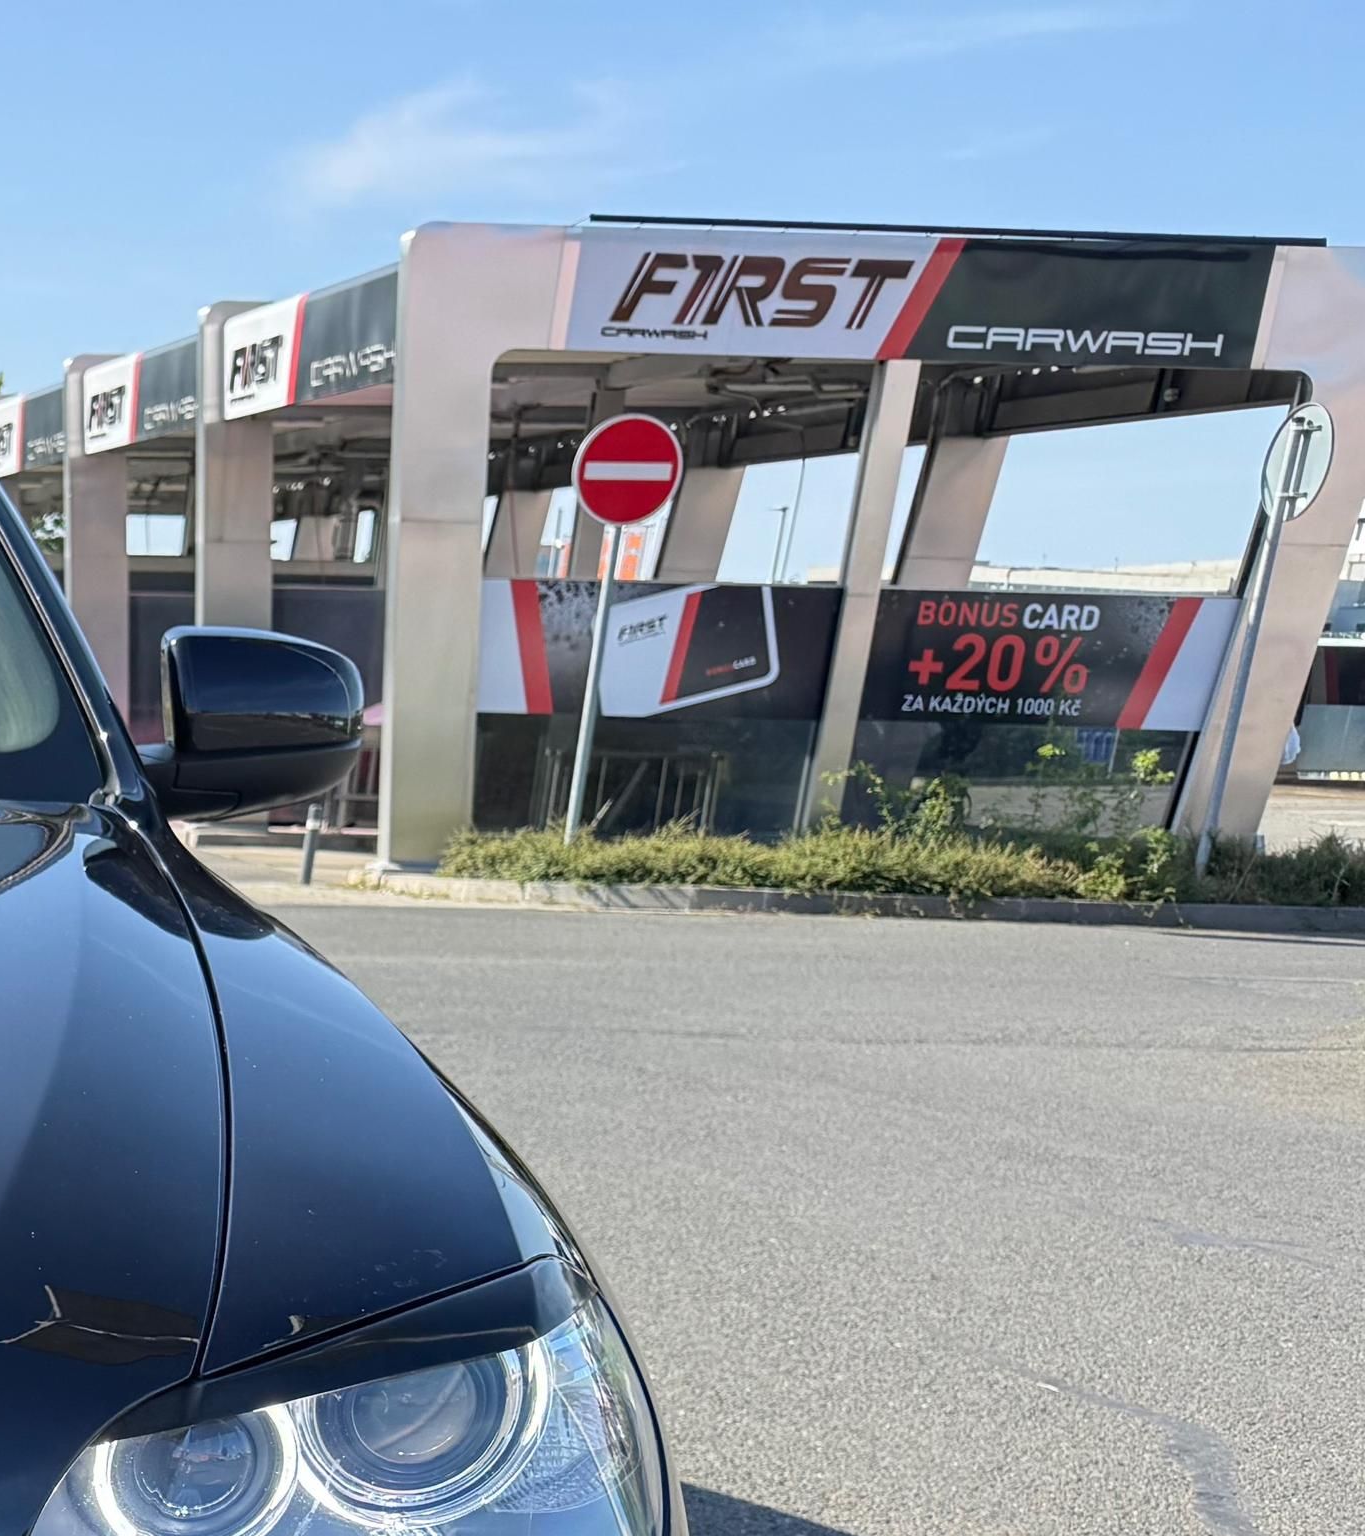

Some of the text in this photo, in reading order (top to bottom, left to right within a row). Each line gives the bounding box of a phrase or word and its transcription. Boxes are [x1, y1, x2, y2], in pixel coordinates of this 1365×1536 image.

[601, 326, 708, 340] CARWASH
[947, 325, 1224, 357] CARWASH
[918, 601, 1100, 631] BONUS CARD
[901, 694, 924, 712] ZA
[928, 692, 1009, 714] KAŽDÝCH
[1018, 698, 1054, 716] 1000
